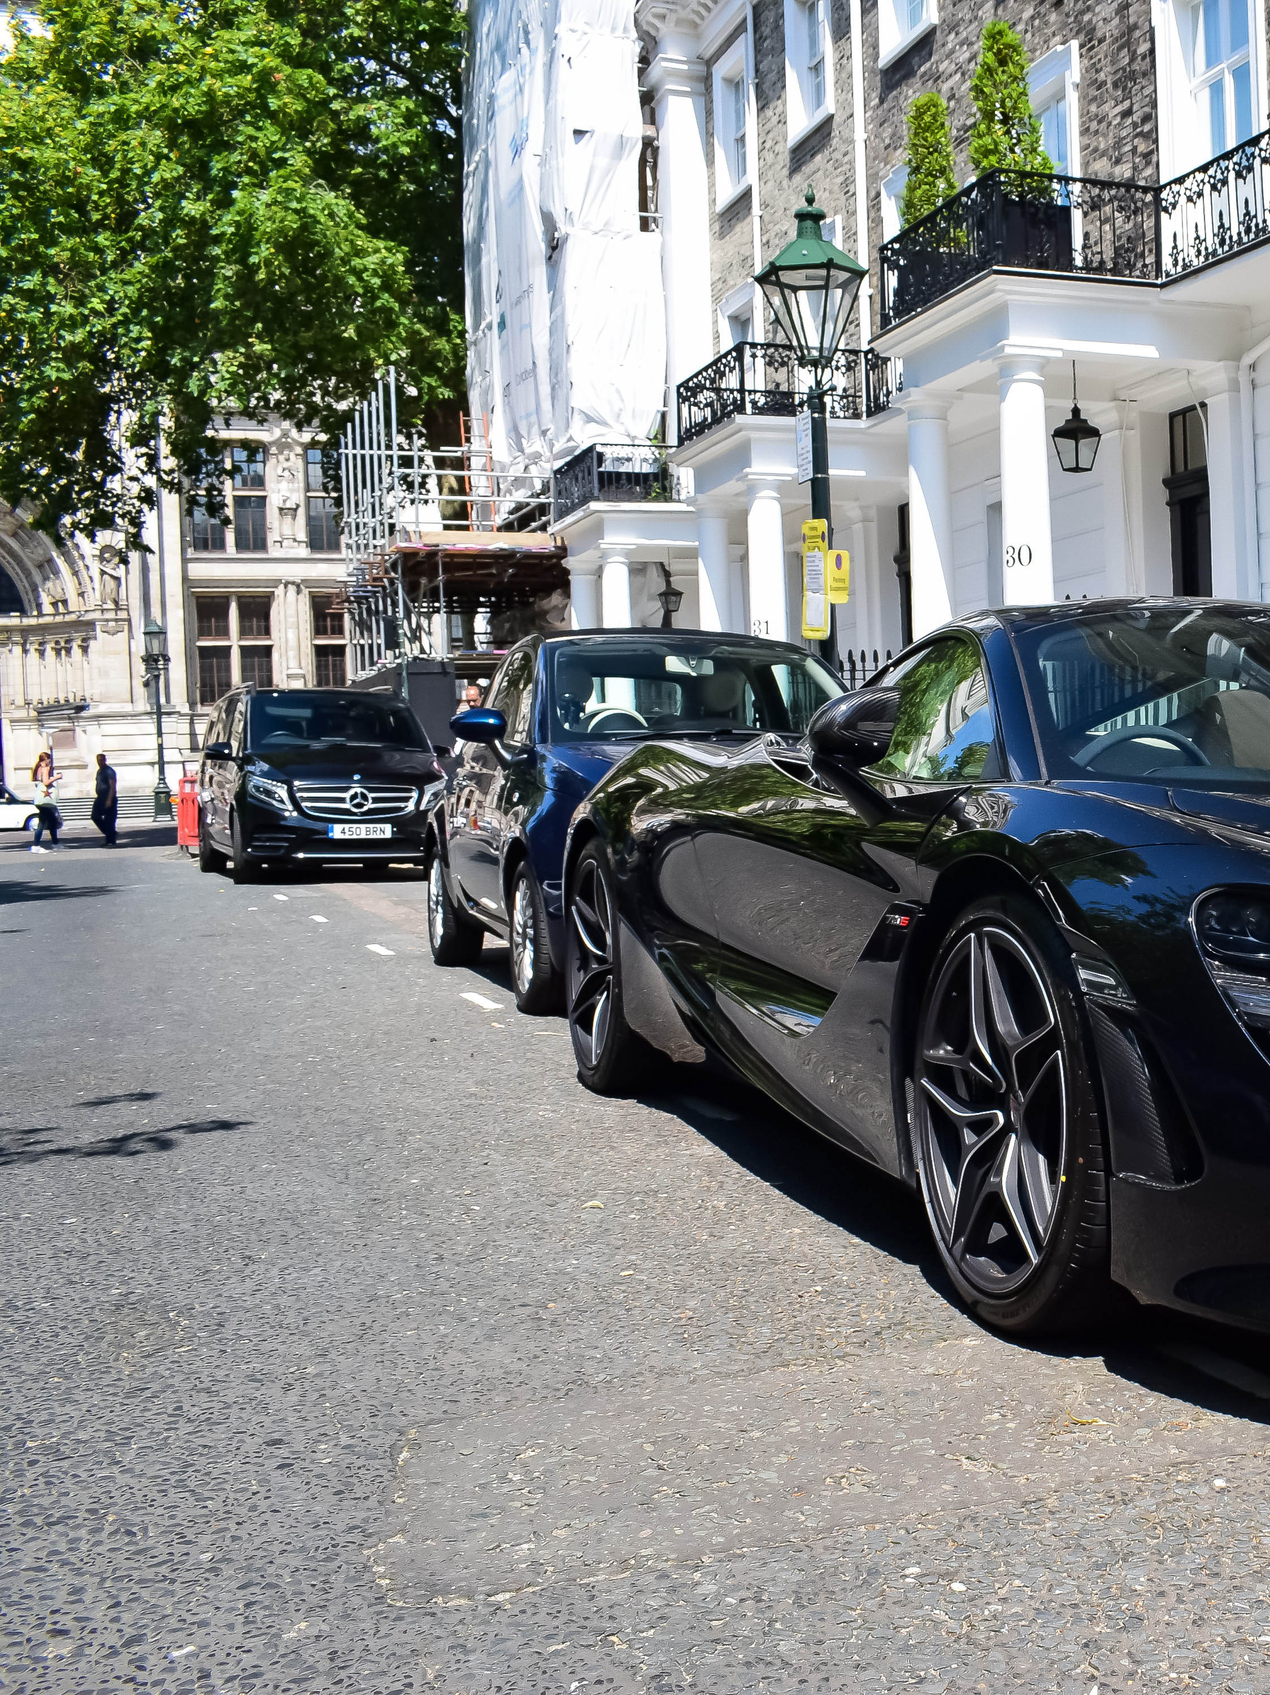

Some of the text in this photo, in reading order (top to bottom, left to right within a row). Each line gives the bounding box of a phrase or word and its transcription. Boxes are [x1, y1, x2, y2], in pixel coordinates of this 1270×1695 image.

[1006, 544, 1032, 568] 30
[753, 619, 769, 637] 31
[340, 826, 386, 836] 450 BRN
